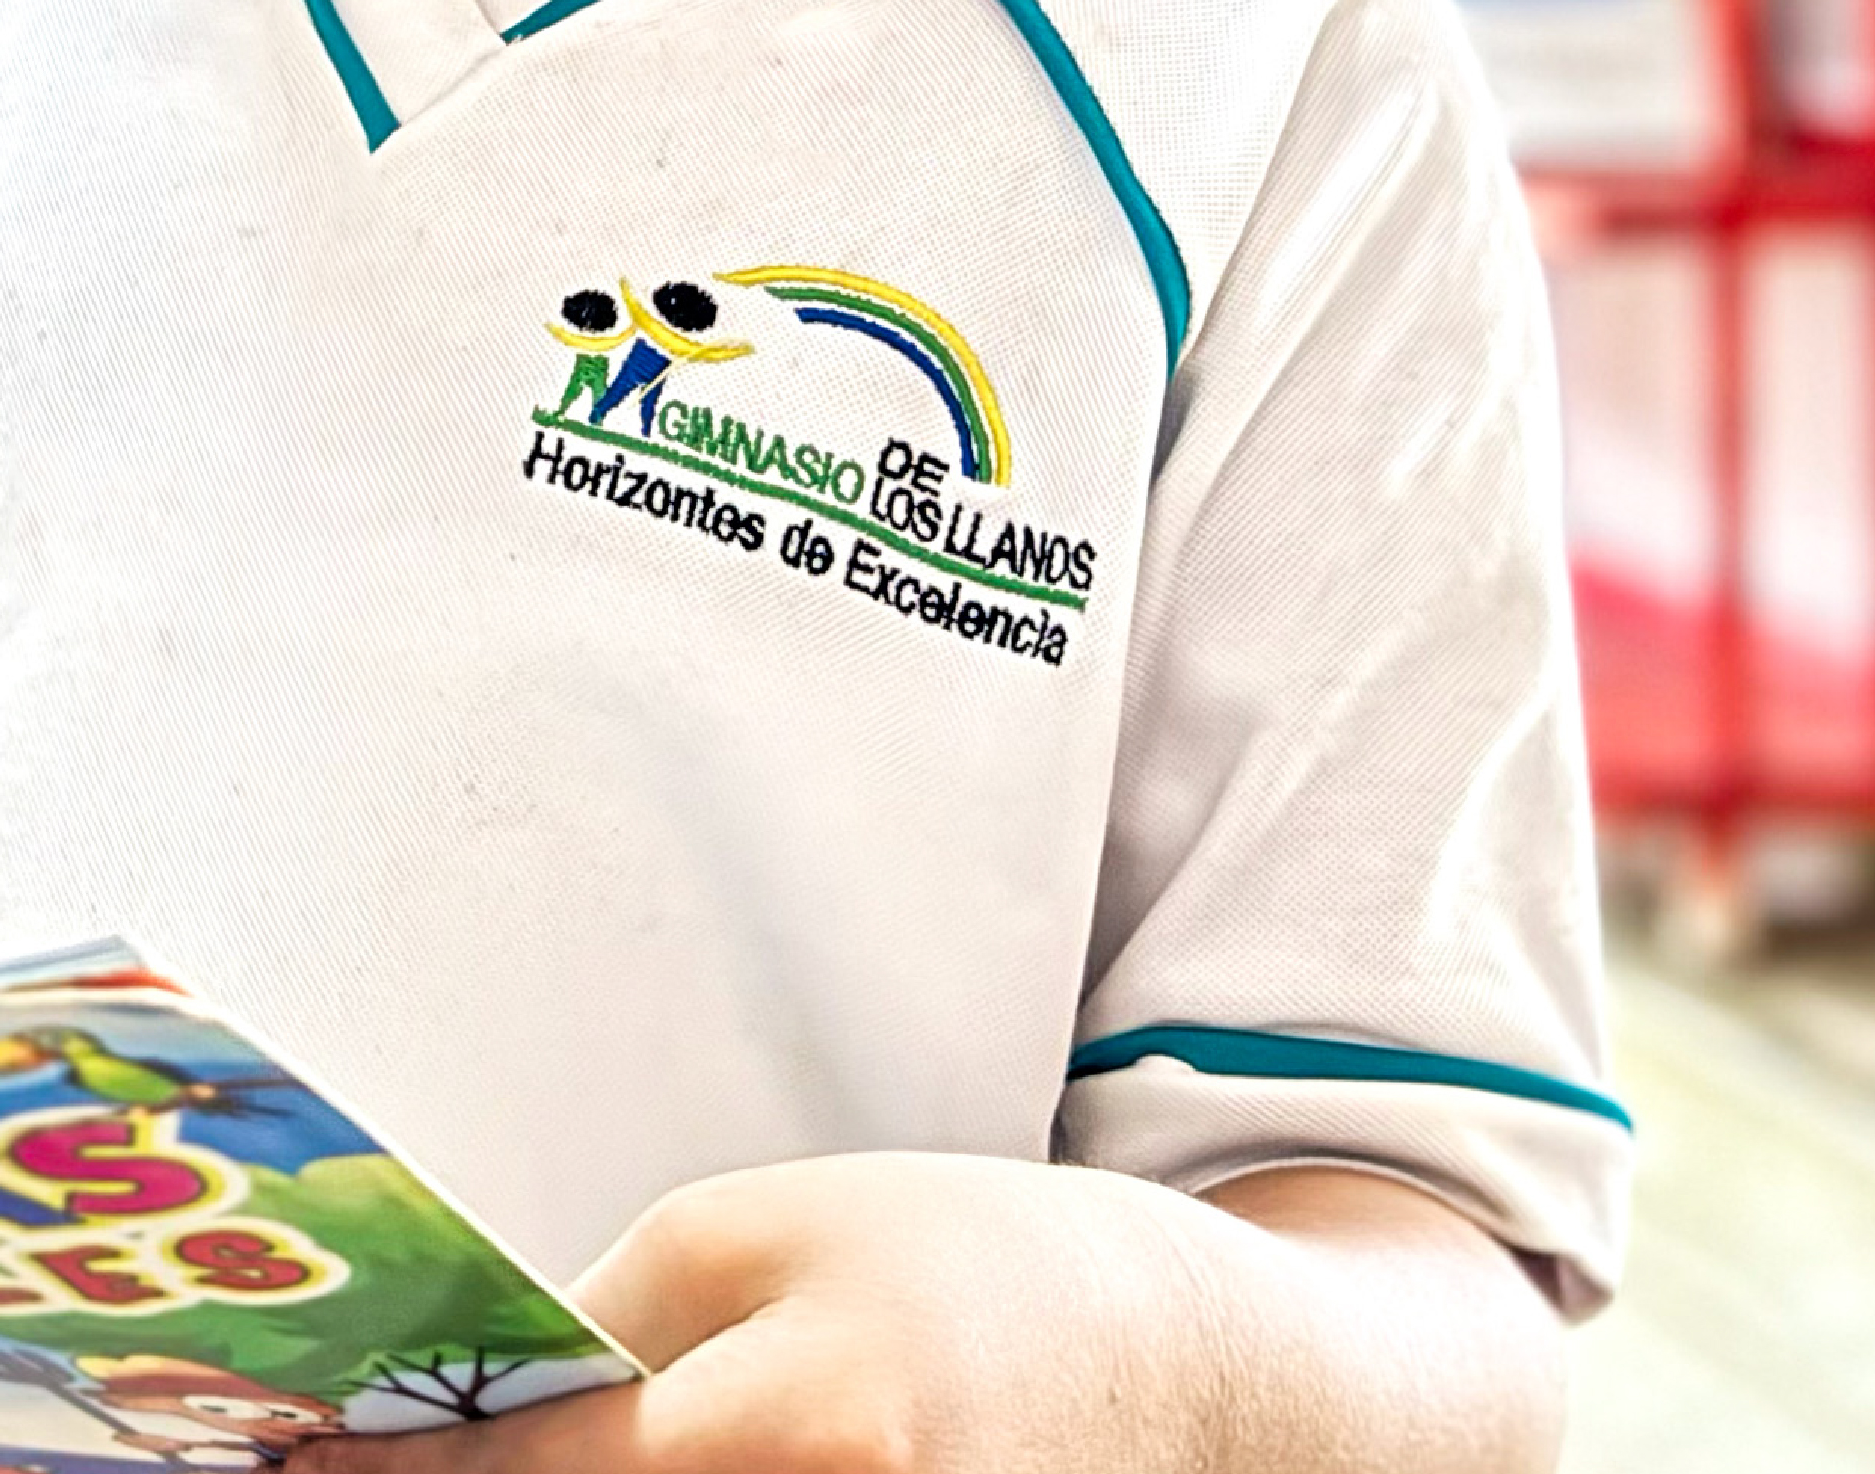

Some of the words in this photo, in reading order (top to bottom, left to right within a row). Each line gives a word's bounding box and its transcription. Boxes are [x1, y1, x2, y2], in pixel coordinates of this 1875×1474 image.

[657, 400, 865, 505] GIMNASIO
[877, 438, 950, 498] DE
[522, 430, 766, 552] Horizontes
[779, 518, 835, 576] de
[843, 538, 1069, 668] Excelencia
[869, 475, 943, 542] LOS
[943, 503, 1098, 592] LLANOS
